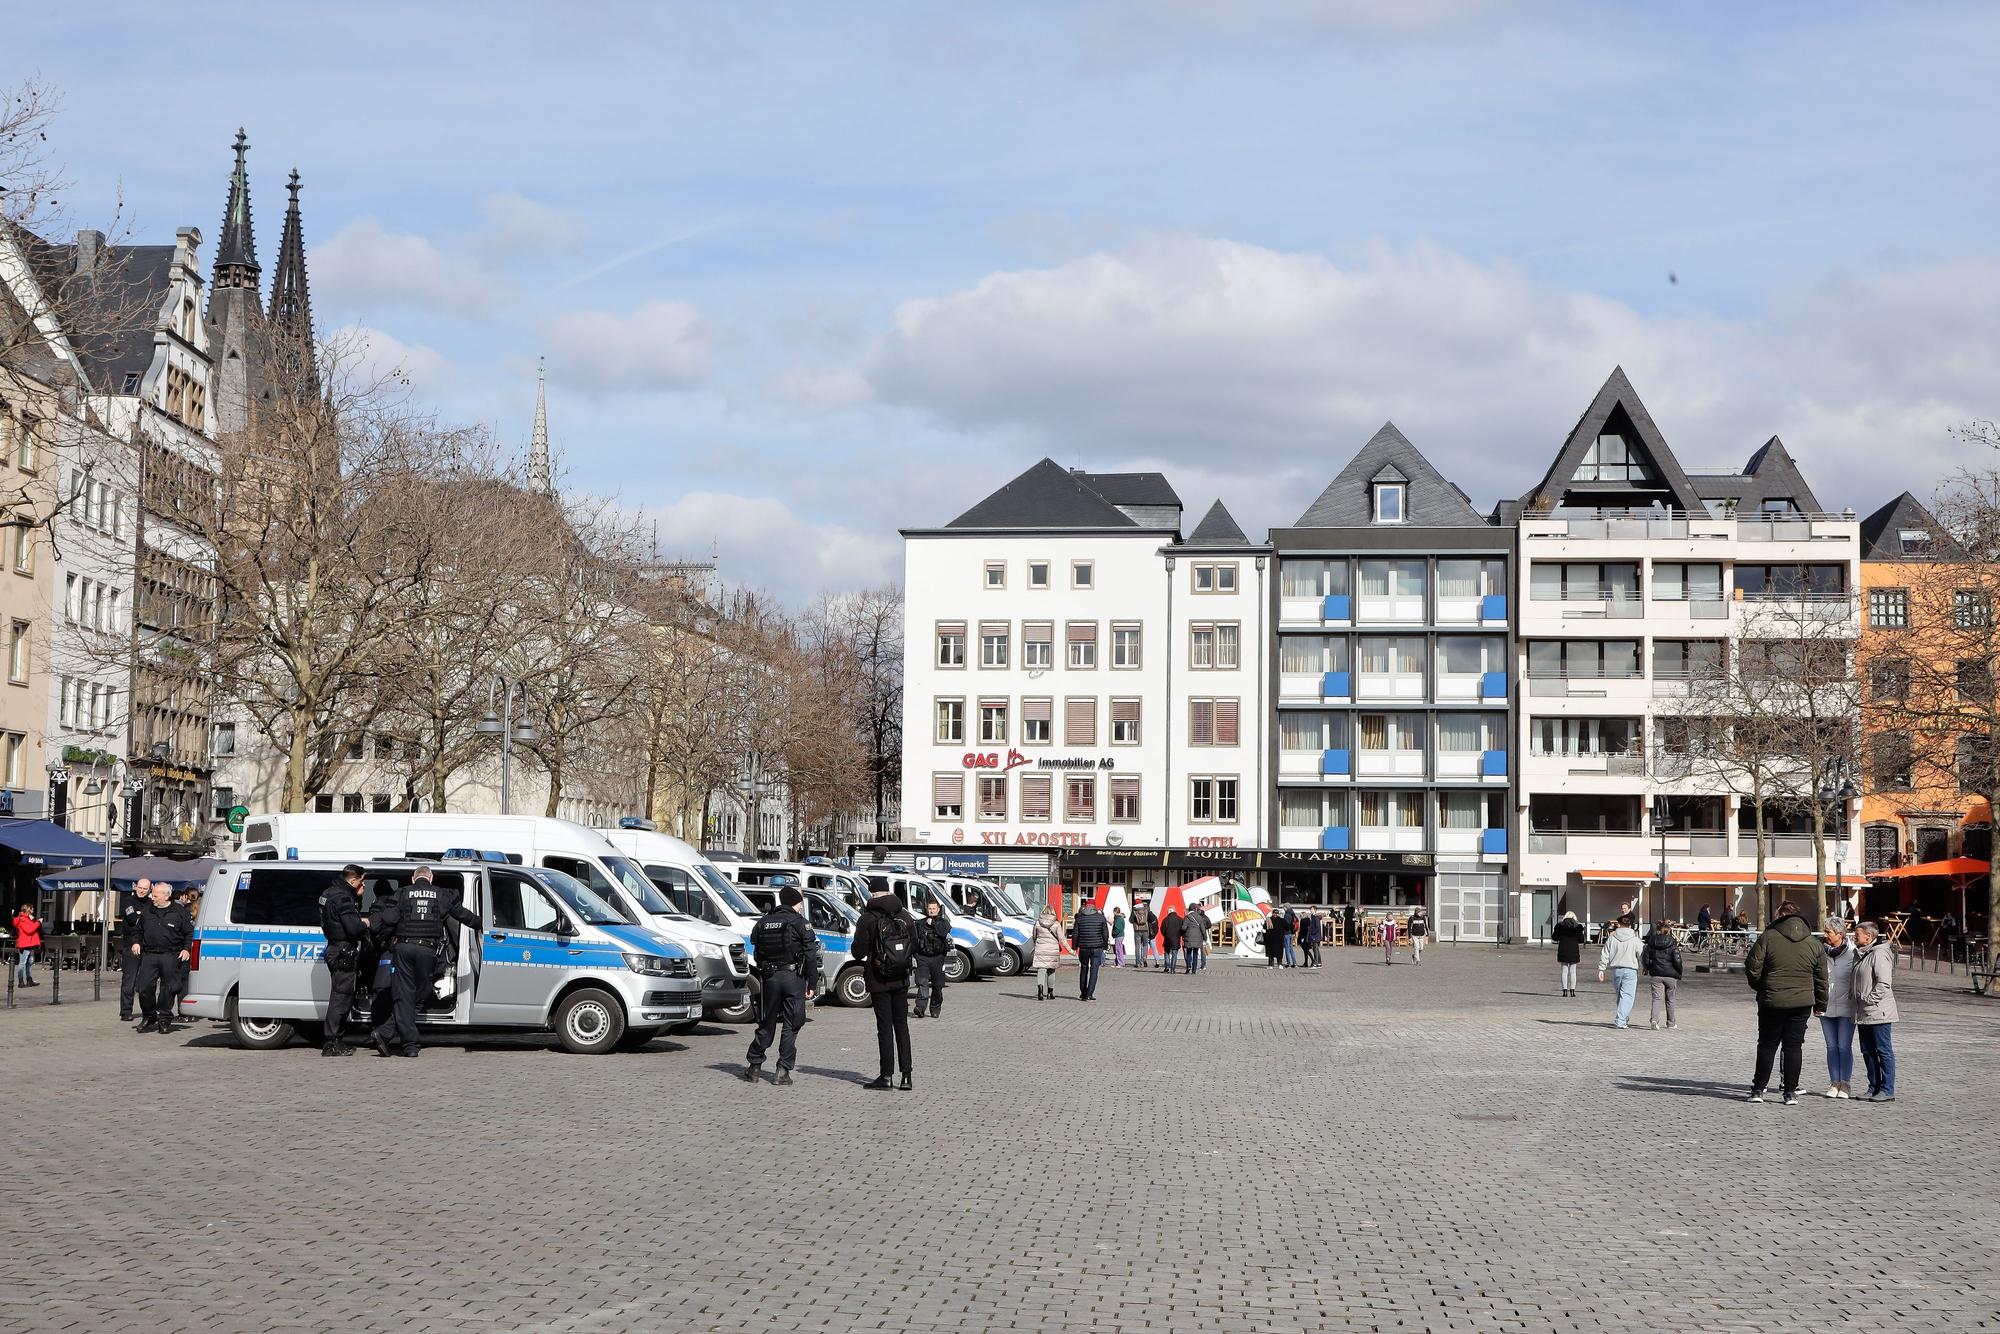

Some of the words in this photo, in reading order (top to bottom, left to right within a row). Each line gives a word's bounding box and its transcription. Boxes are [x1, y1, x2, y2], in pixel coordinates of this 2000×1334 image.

[963, 753, 998, 768] GAG
[1038, 757, 1096, 769] Immobilien
[1098, 758, 1115, 769] AG
[981, 832, 1007, 845] XII
[1015, 832, 1091, 847] APOSTEL
[1189, 837, 1238, 848] HOTEL
[1185, 851, 1242, 860] HOTEL
[1308, 853, 1387, 861] APOSTEL
[948, 860, 985, 868] Heumarkt
[409, 890, 437, 899] POLIZEI
[416, 906, 428, 914] 313
[259, 943, 325, 960] POLIZE
